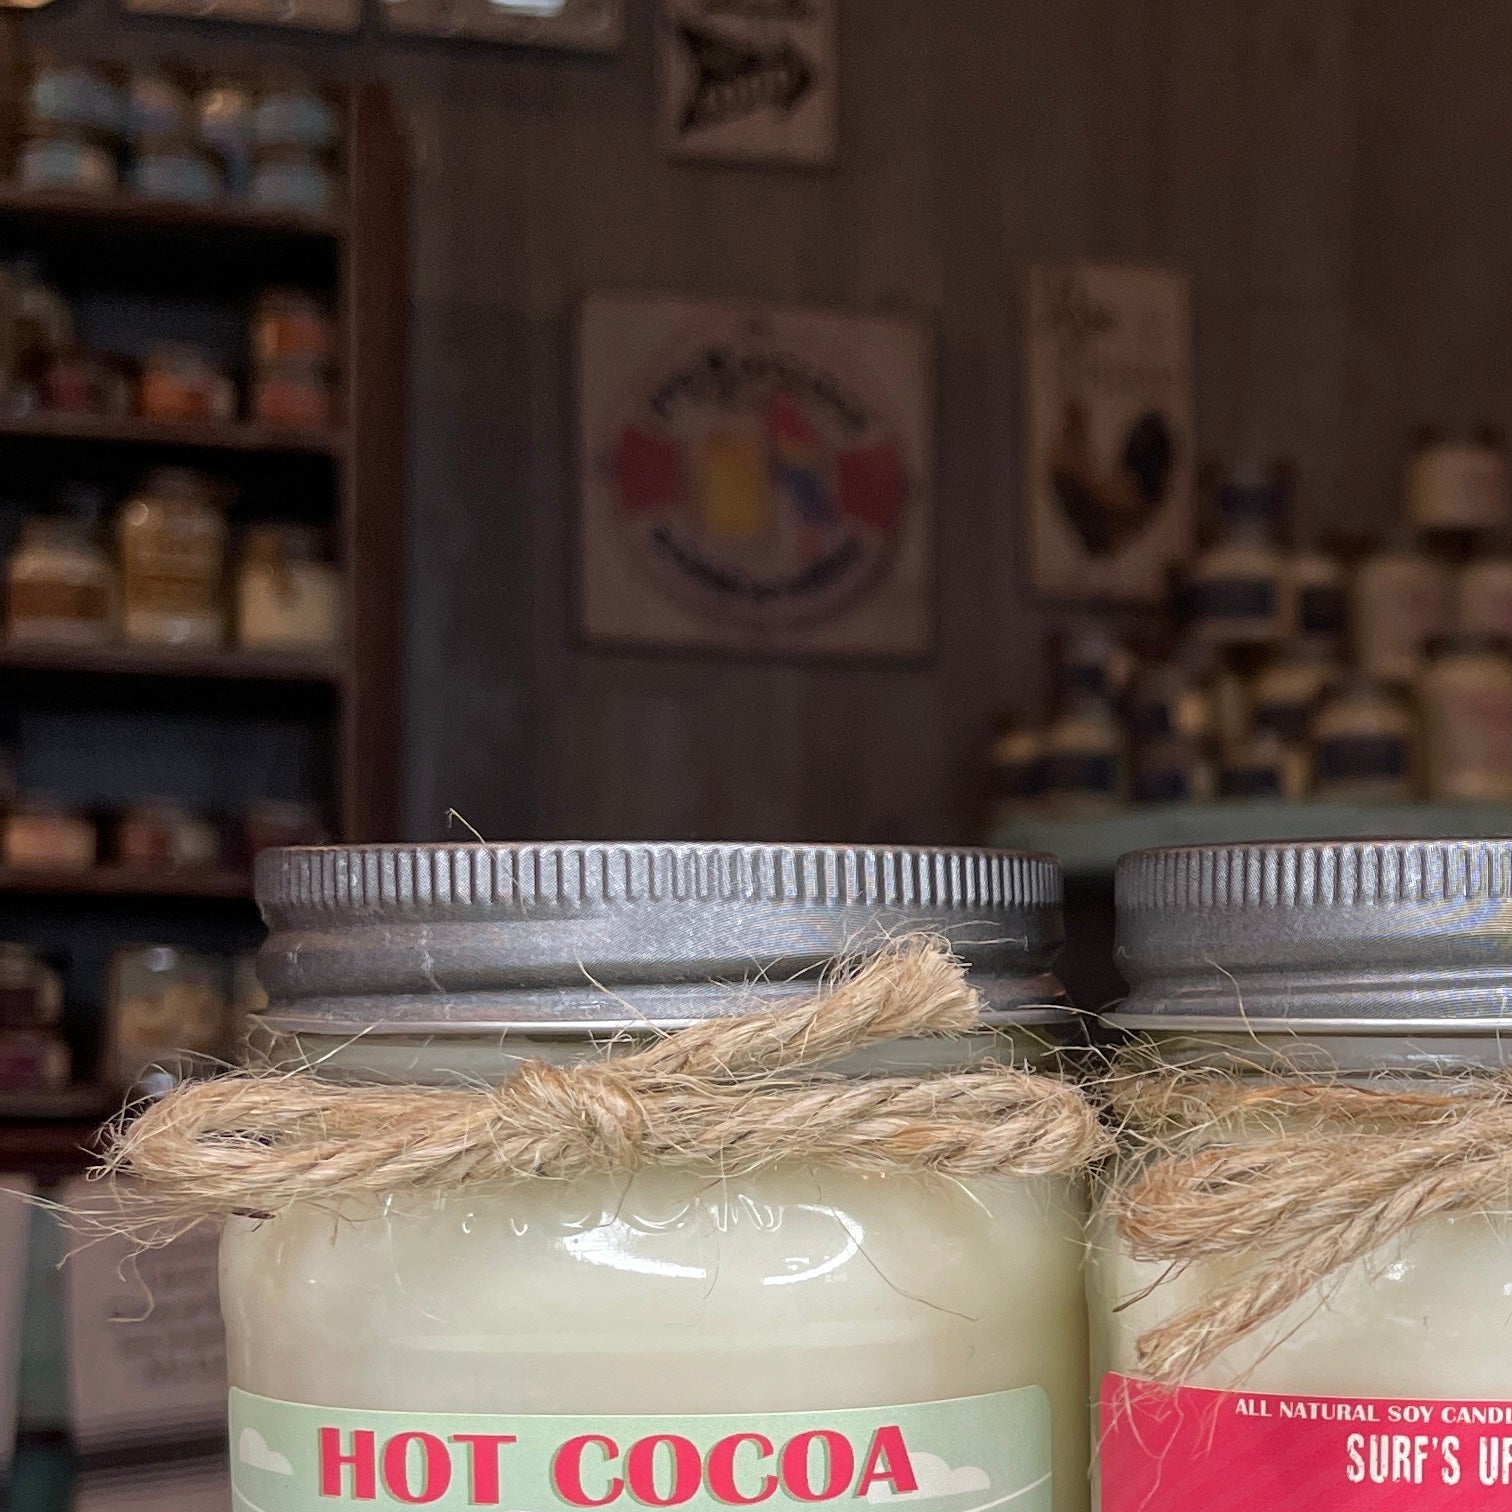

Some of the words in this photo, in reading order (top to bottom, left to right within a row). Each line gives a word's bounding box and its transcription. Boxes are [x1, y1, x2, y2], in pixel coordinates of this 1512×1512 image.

[1235, 1398, 1272, 1419] ALL
[1279, 1401, 1381, 1422] NATURAL
[1388, 1404, 1433, 1424] SOY
[318, 1426, 516, 1506] HOT
[551, 1425, 919, 1508] COCOA
[1346, 1433, 1461, 1486] SURF'S
